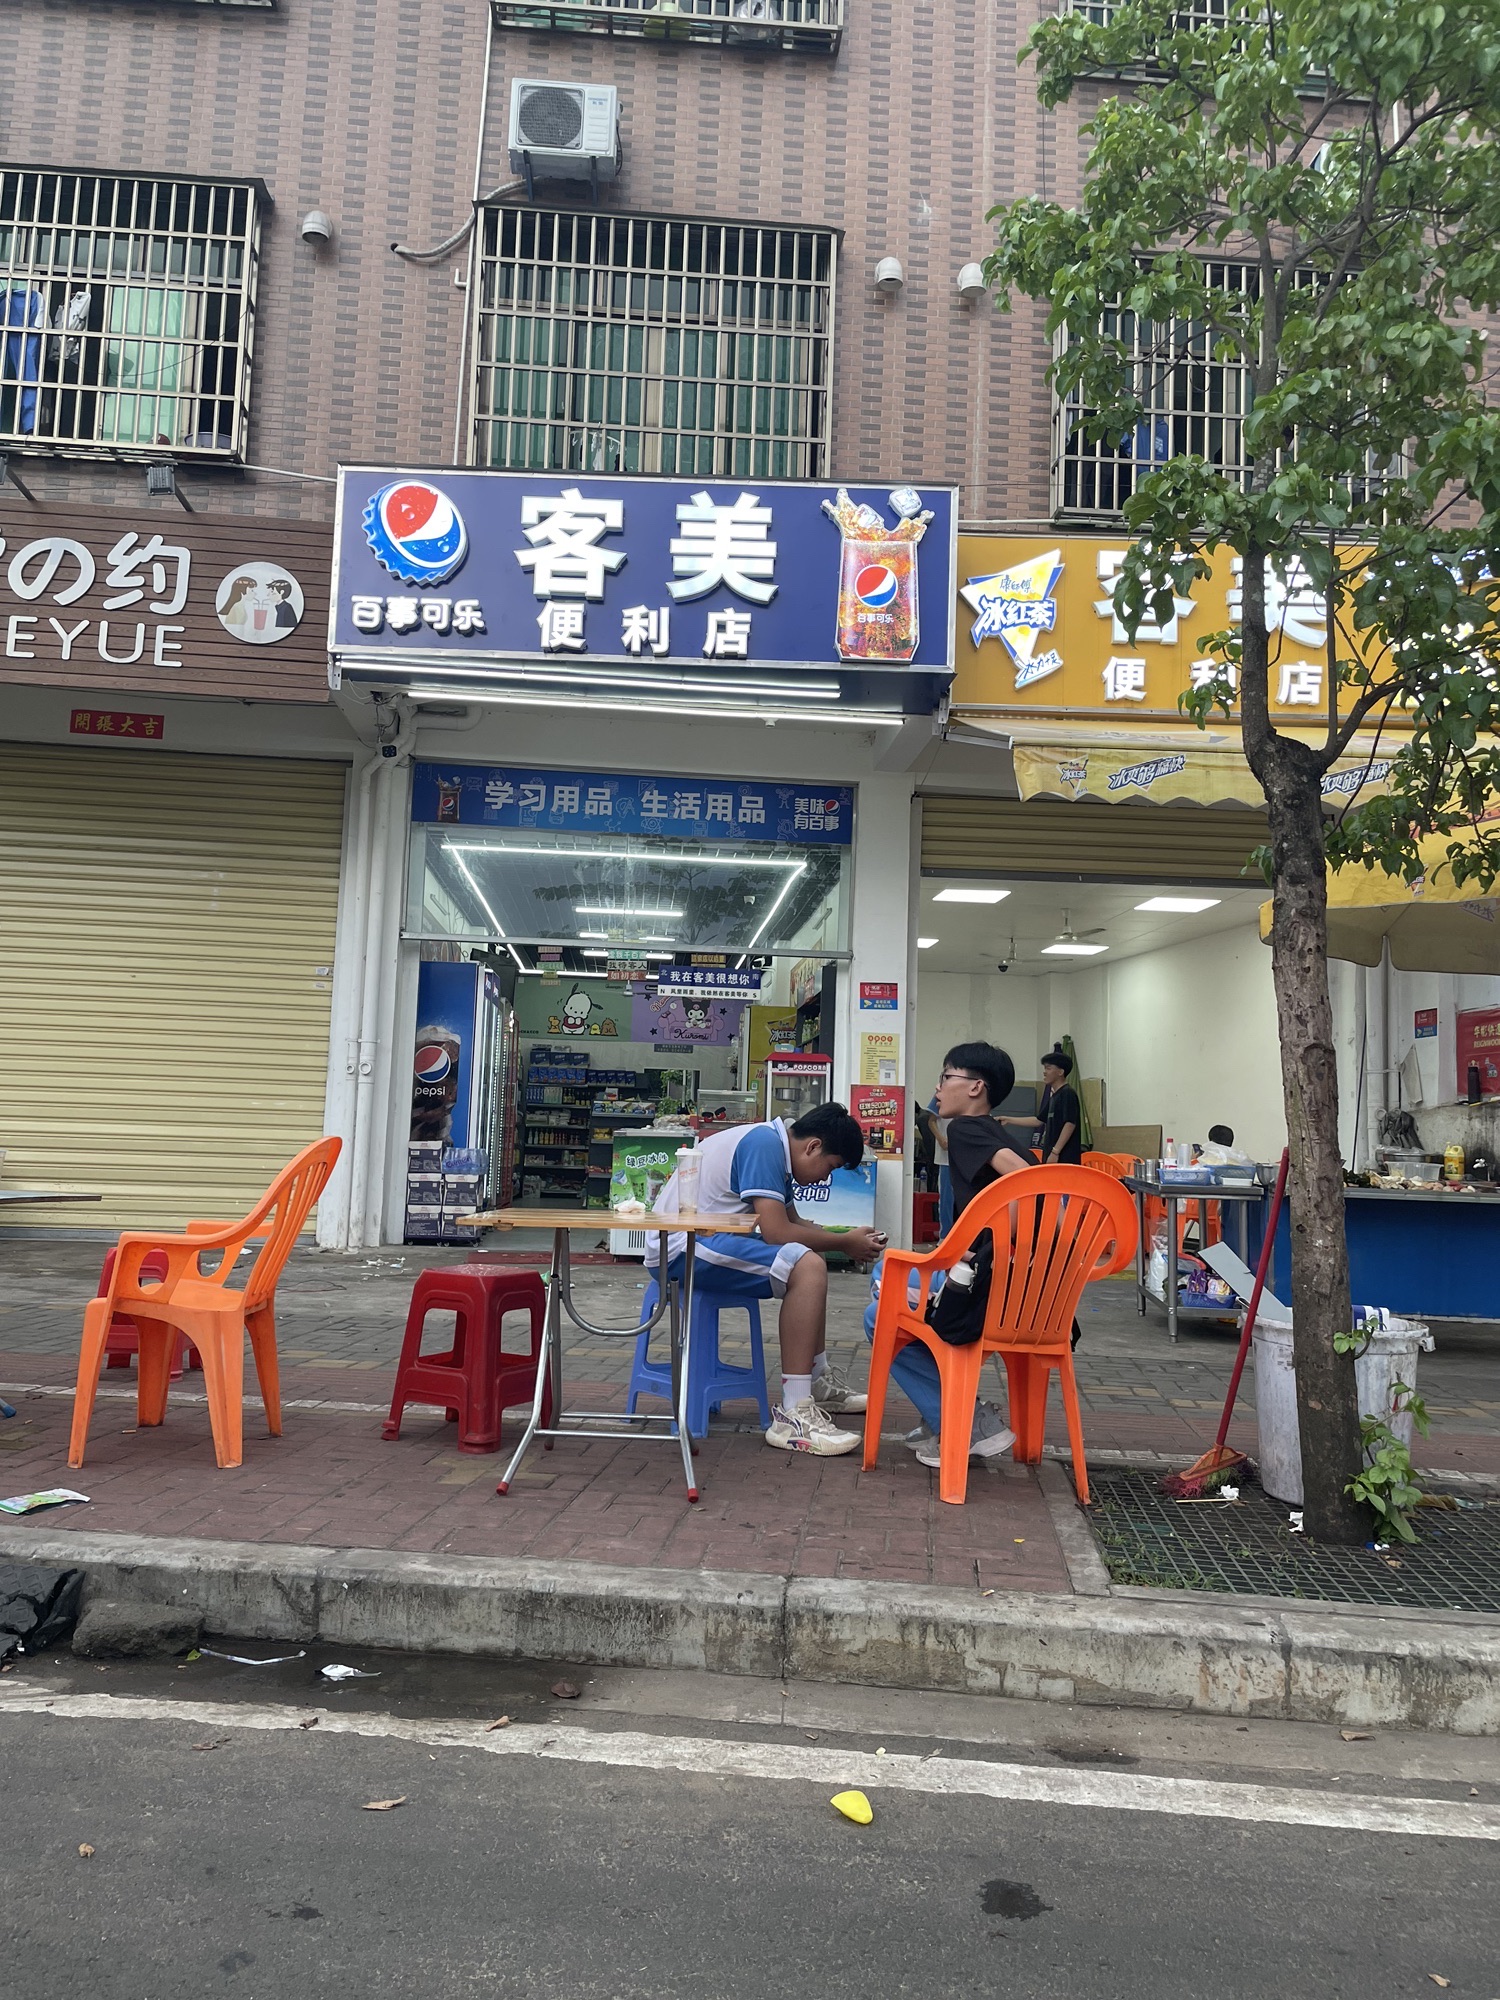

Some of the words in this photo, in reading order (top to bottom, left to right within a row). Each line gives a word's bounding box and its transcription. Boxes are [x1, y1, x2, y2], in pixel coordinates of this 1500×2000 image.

[513, 487, 779, 604] 客美
[0, 528, 191, 615] の约
[350, 595, 486, 634] 百事可乐
[857, 613, 894, 623] 百事可乐
[976, 597, 1054, 636] 冰红茶
[536, 601, 752, 657] 便利店
[1101, 656, 1323, 706] 便利店
[74, 713, 159, 736] 開張大吉
[485, 781, 613, 817] 学习用品
[640, 789, 766, 824] 生活用品
[794, 797, 824, 814] 美味
[793, 814, 840, 832] 有百事
[670, 971, 750, 986] 我在客美很想你
[673, 1028, 709, 1040] Kuromi
[414, 1086, 446, 1098] pepsi
[625, 1152, 669, 1168] 绿豆冰沙
